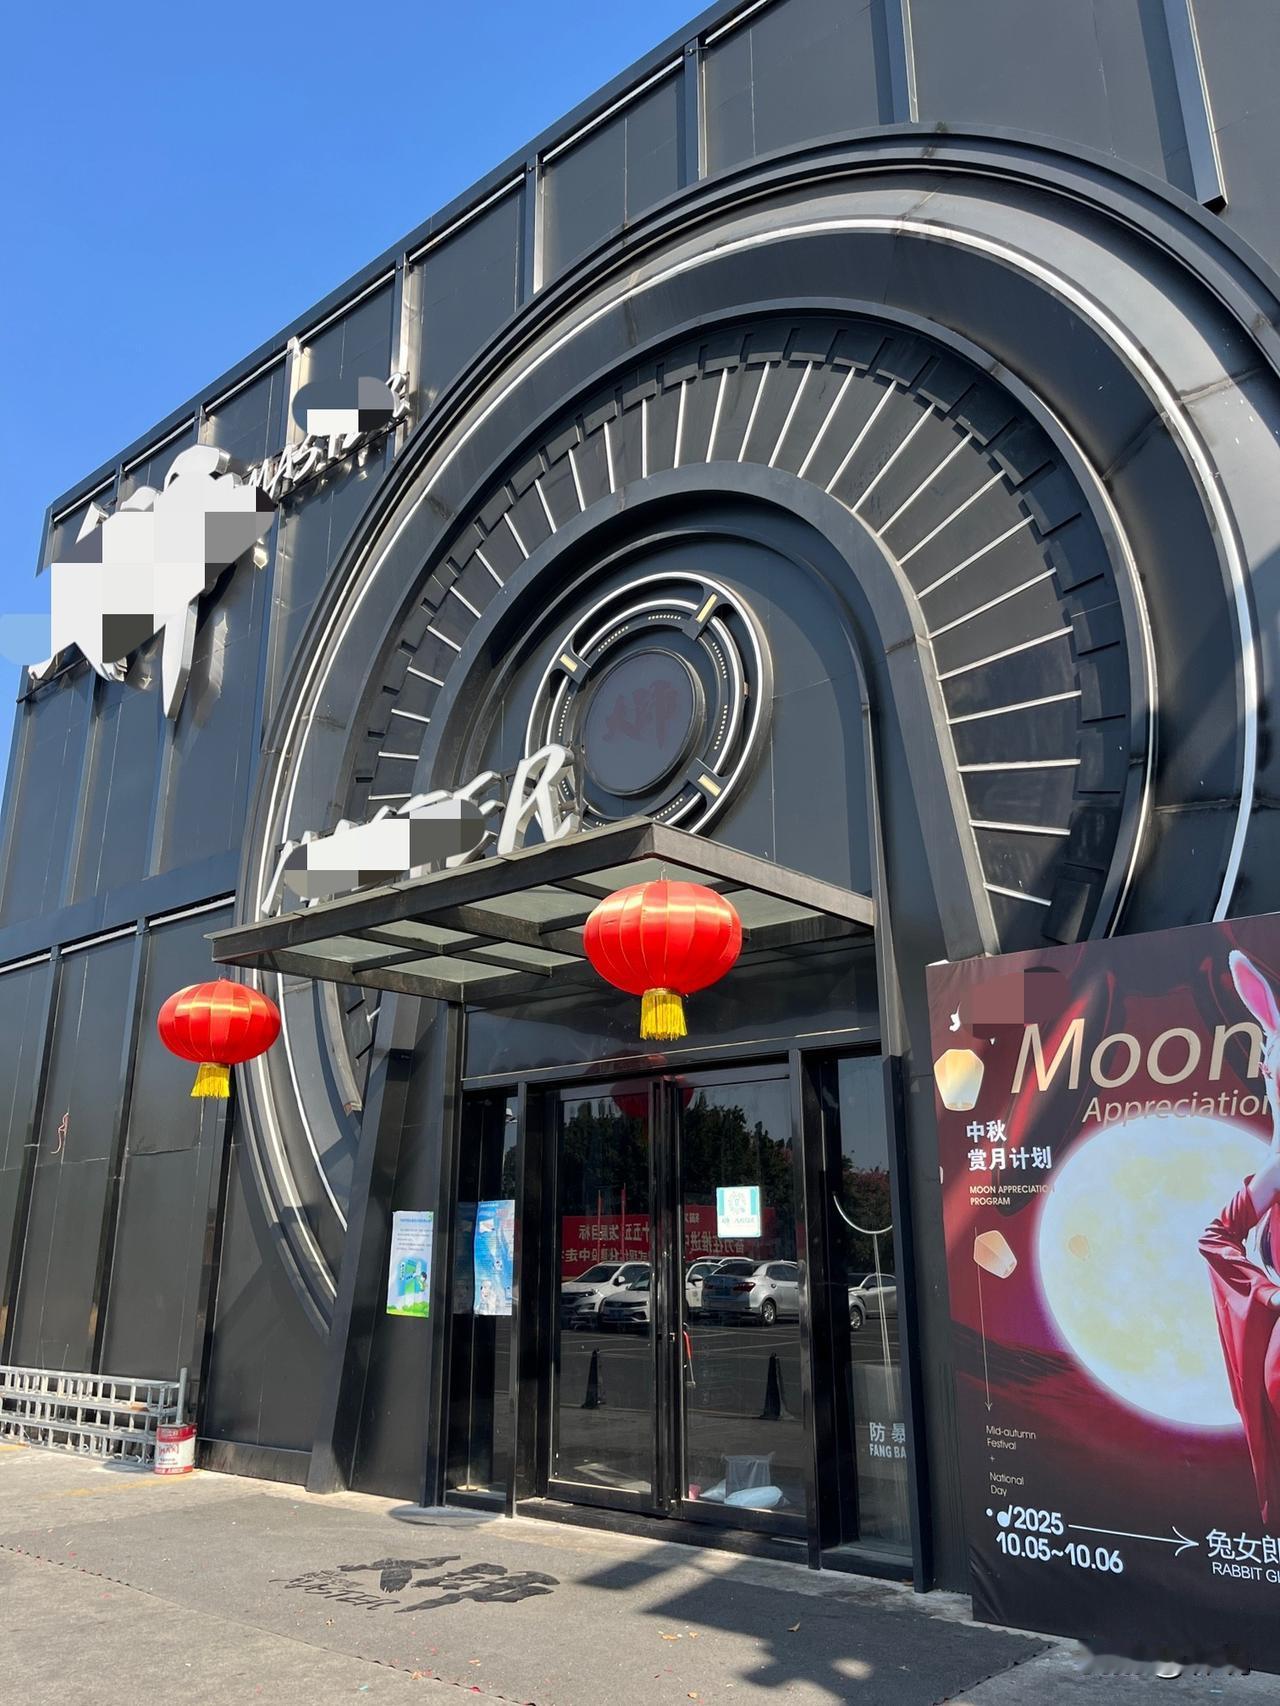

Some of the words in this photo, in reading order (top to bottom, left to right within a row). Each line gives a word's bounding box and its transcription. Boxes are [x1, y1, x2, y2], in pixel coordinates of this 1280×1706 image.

[1011, 1018, 1264, 1094] Moon
[966, 1119, 1007, 1143] 中秋
[967, 1146, 1052, 1171] 赏月计划
[969, 1185, 997, 1194] MOON
[970, 1196, 1011, 1206] PROGRAM
[985, 1424, 1037, 1440] Mid-autumn
[869, 1443, 892, 1459] FANG
[986, 1437, 1017, 1450] Festival
[989, 1471, 1025, 1486] National
[990, 1484, 1008, 1497] Day
[1012, 1506, 1064, 1536] 2025
[996, 1531, 1124, 1574] 10.05~10.06
[1212, 1561, 1263, 1581] RABBIT
